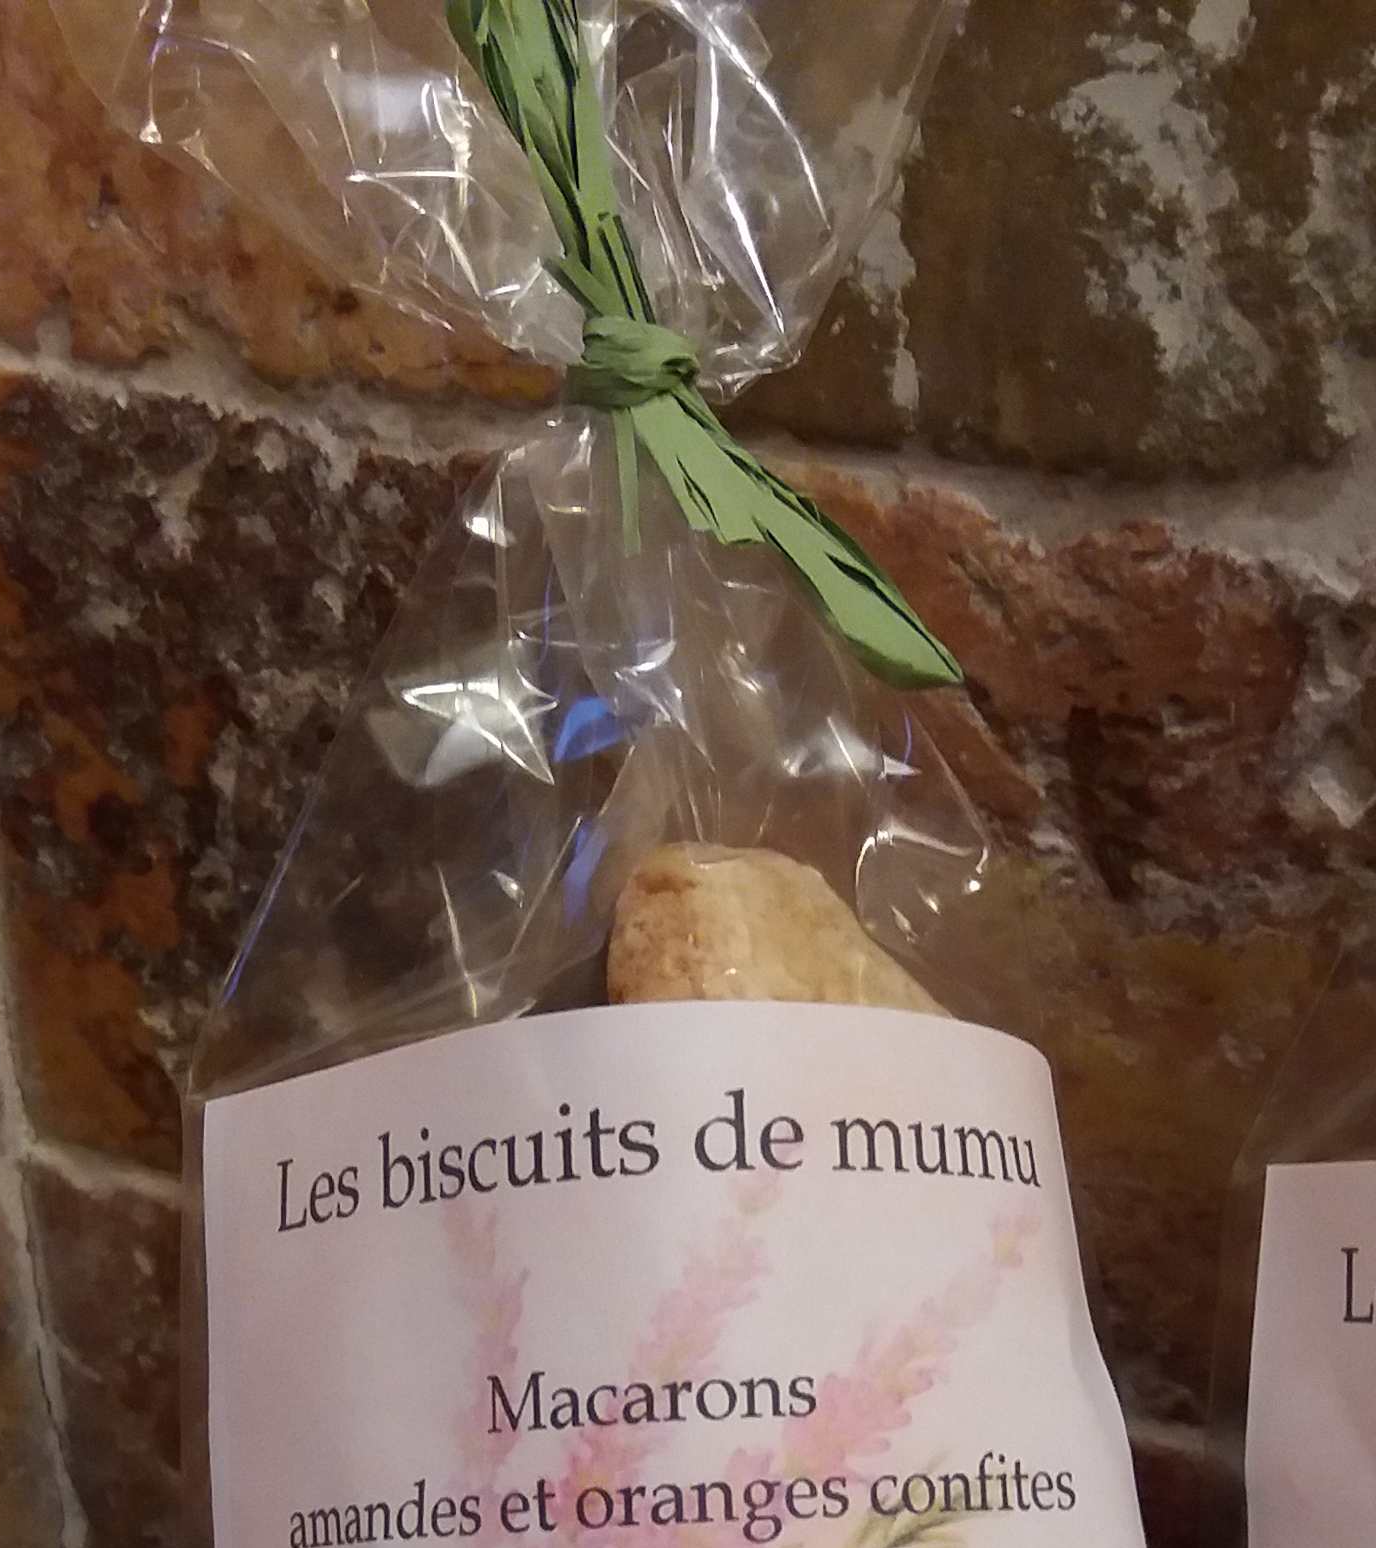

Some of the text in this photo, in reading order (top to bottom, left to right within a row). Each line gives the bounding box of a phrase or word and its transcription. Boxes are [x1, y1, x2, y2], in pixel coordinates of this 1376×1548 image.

[277, 1089, 1040, 1232] Les biscuits de mumu
[487, 1372, 816, 1433] Macarons
[501, 1479, 557, 1533] et
[576, 1477, 849, 1543] oranges
[871, 1452, 1075, 1516] confites
